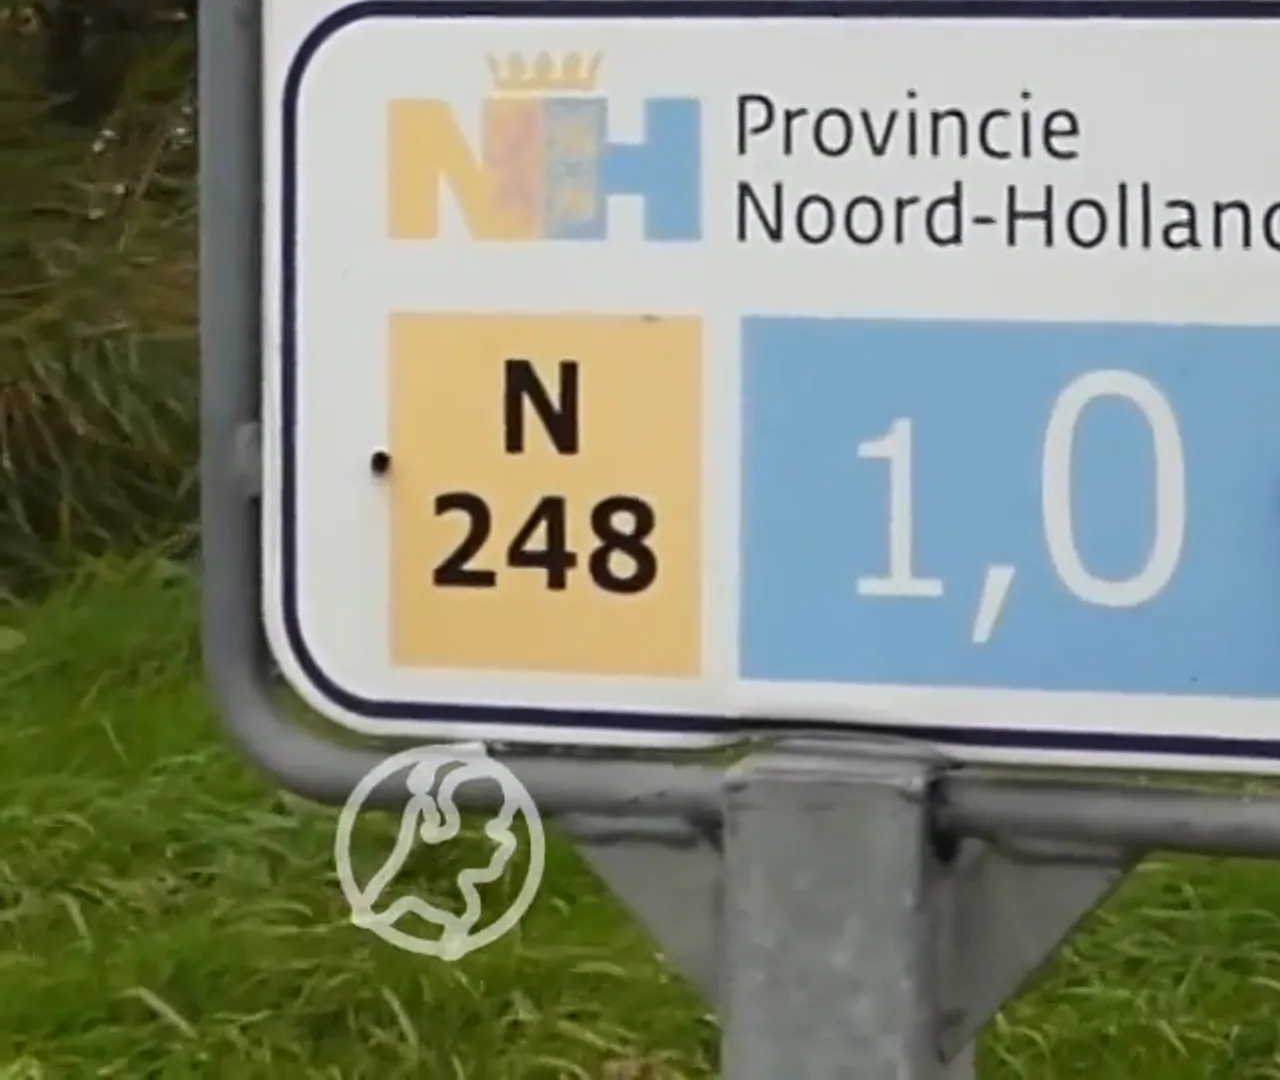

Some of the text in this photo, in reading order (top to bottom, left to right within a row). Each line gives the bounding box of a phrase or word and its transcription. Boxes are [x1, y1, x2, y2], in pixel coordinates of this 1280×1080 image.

[736, 91, 1081, 161] Provincie
[503, 359, 579, 455] N
[432, 492, 658, 594] 248
[855, 368, 1189, 644] 1,0
